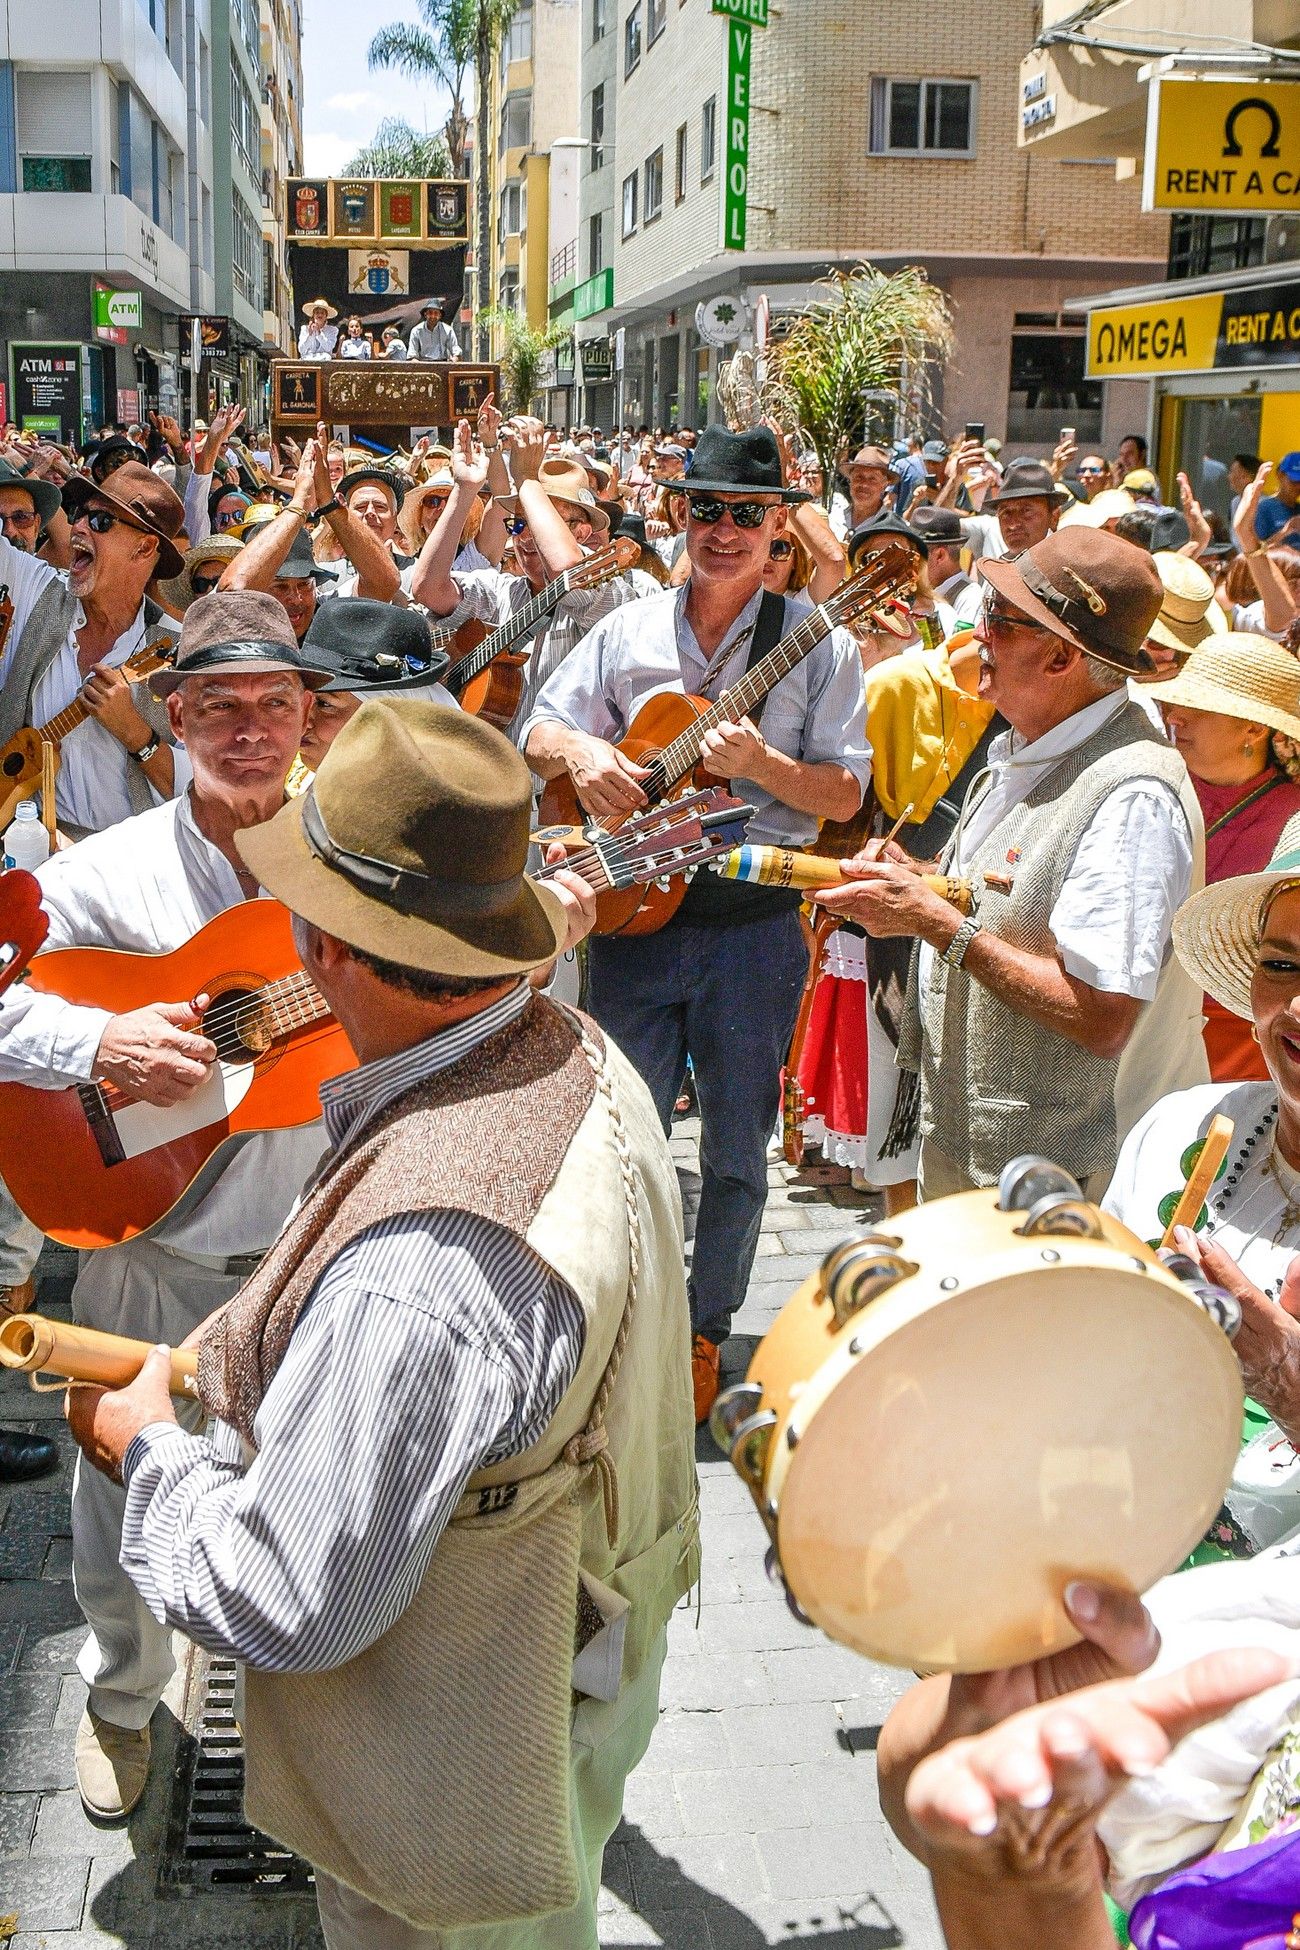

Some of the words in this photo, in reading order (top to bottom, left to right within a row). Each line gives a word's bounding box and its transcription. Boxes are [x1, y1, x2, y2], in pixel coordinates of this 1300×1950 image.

[730, 29, 748, 241] VEROL
[1166, 169, 1237, 194] RENT
[1244, 170, 1263, 194] A
[1272, 171, 1300, 195] C
[111, 303, 138, 314] ATM
[1226, 312, 1270, 346] RENT
[1270, 310, 1286, 341] A
[20, 359, 52, 372] ATM
[586, 351, 608, 364] PUB
